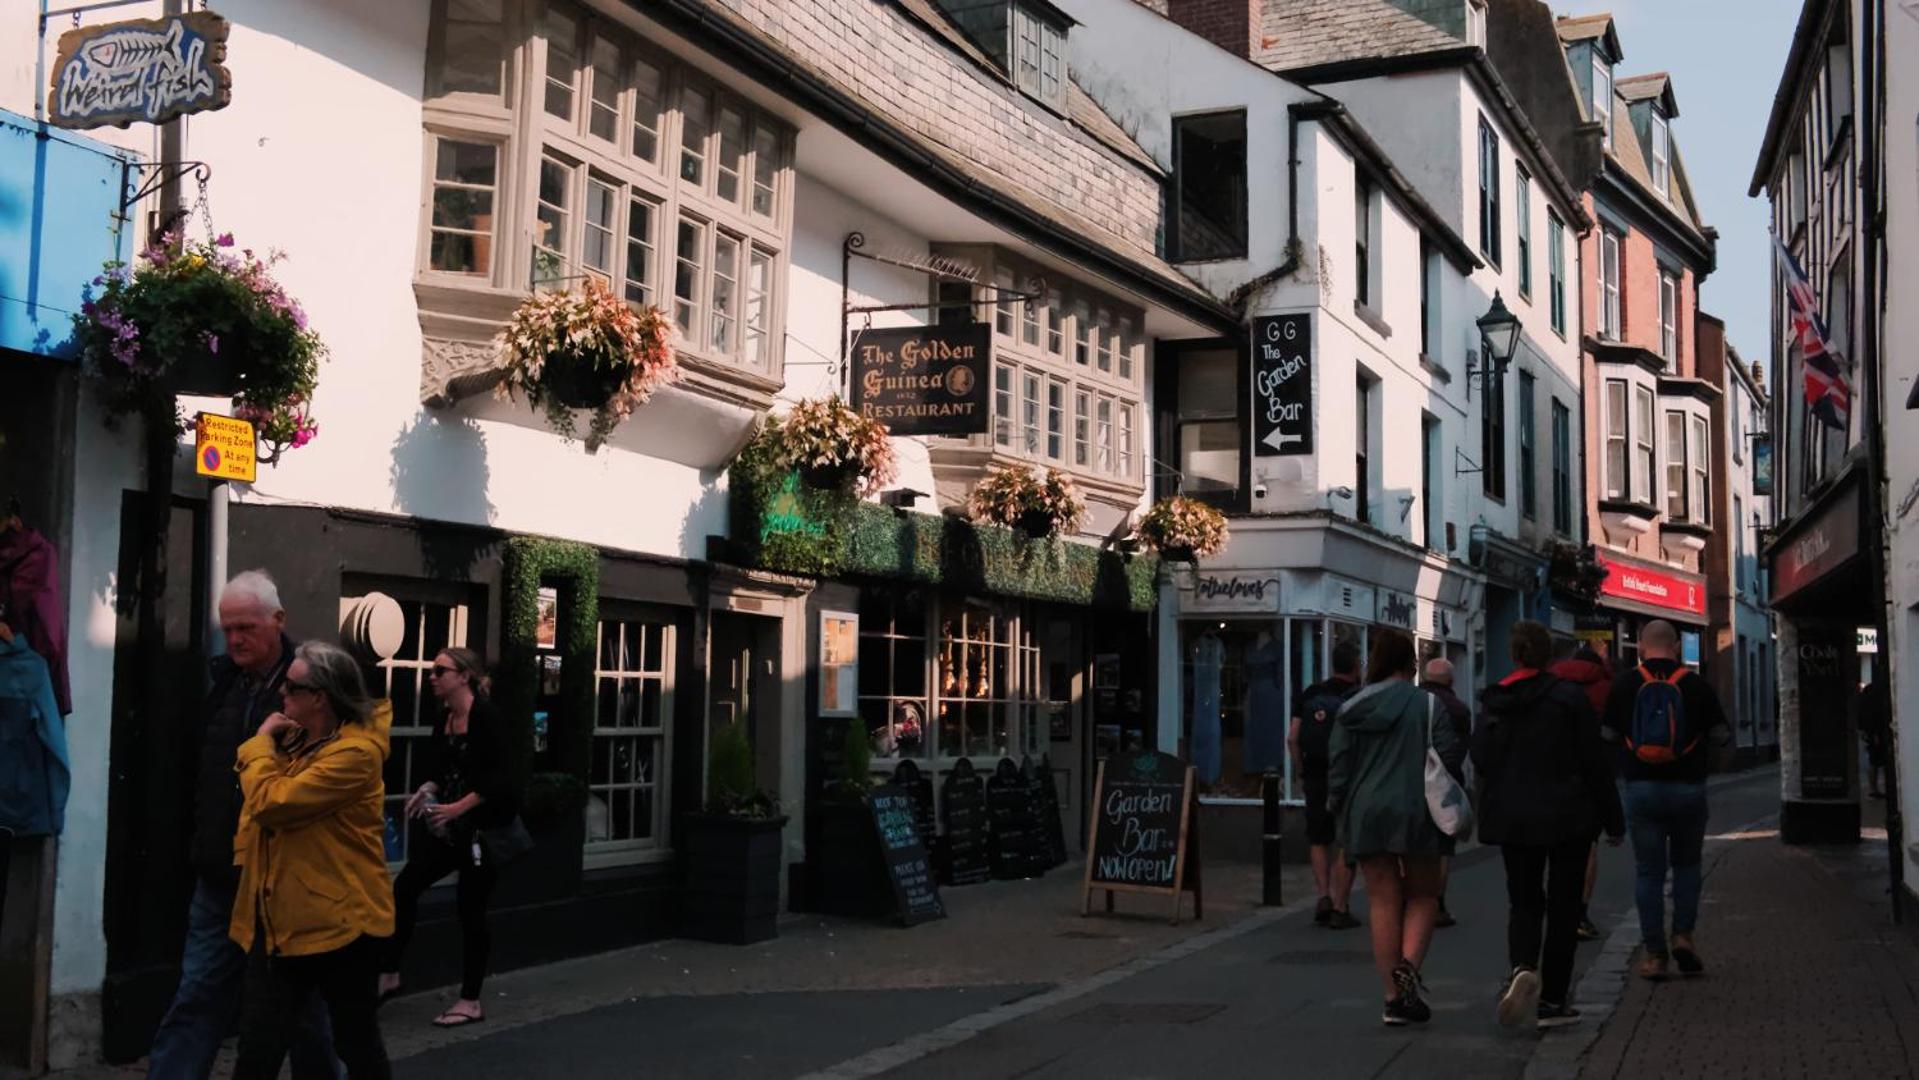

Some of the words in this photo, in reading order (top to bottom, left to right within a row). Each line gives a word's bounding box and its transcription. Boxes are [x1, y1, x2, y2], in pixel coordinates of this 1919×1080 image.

[861, 344, 894, 365] The
[900, 338, 976, 369] Golden
[1262, 344, 1282, 359] The
[863, 369, 945, 399] Guinea
[1257, 354, 1307, 398] Garden
[1266, 397, 1304, 424] Bar
[205, 417, 249, 435] Restricted
[233, 435, 254, 449] Zone
[224, 449, 235, 461] At
[236, 454, 251, 465] any
[228, 464, 247, 475] time
[1105, 787, 1173, 825] Garden
